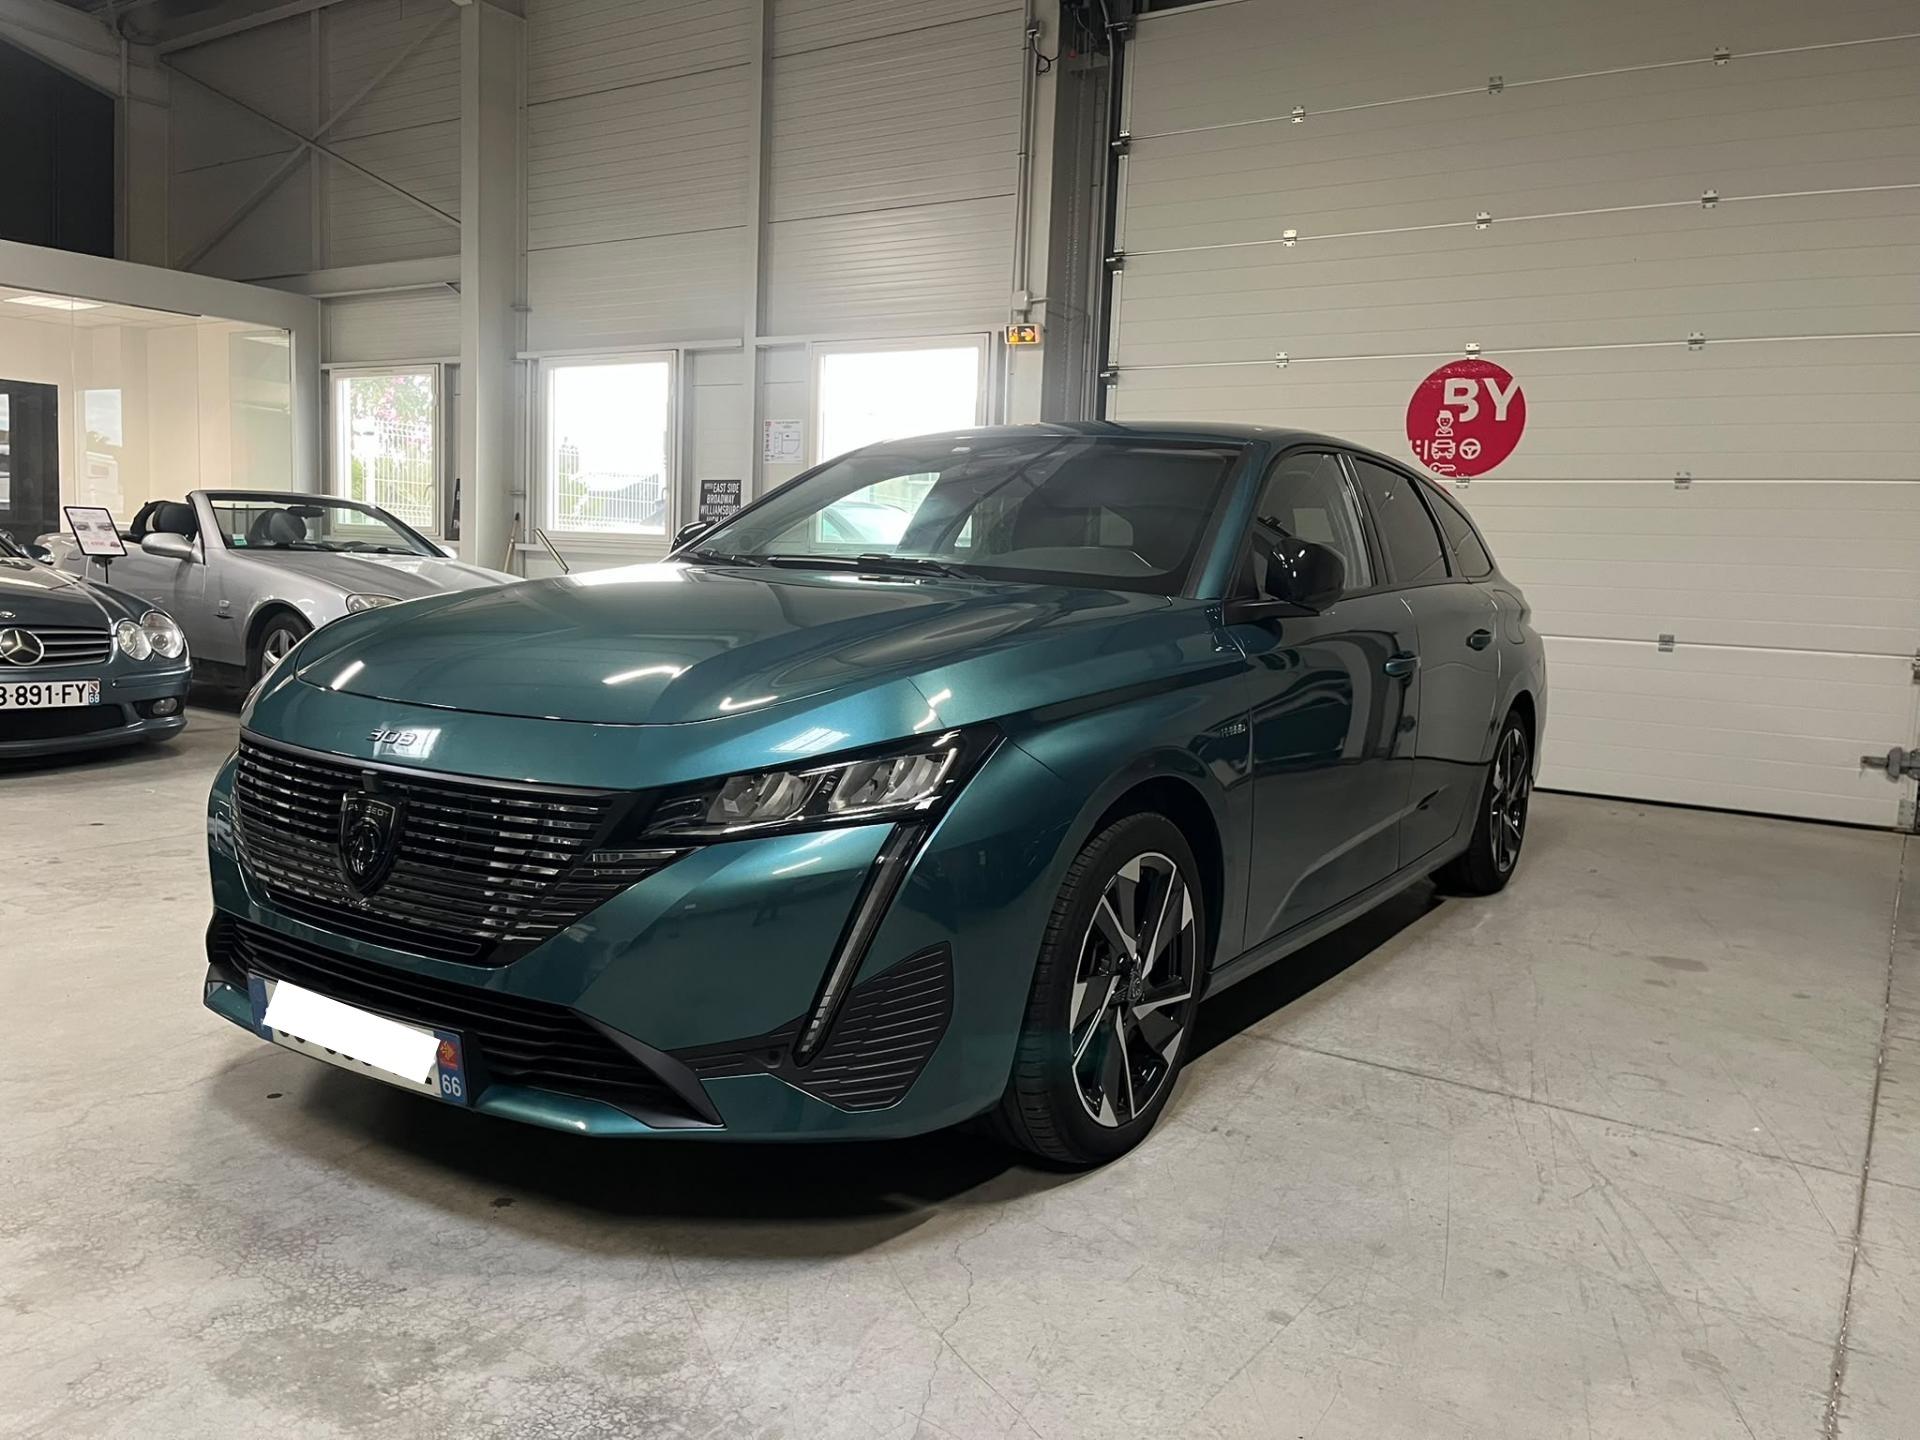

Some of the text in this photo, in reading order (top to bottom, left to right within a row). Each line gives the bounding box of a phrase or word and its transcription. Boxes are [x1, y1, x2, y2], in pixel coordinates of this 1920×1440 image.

[1443, 376, 1519, 423] BY
[713, 483, 726, 493] EAST
[727, 483, 740, 493] SIDE
[706, 494, 735, 504] BROADWAY
[366, 728, 418, 746] 308
[441, 1073, 462, 1097] 66
